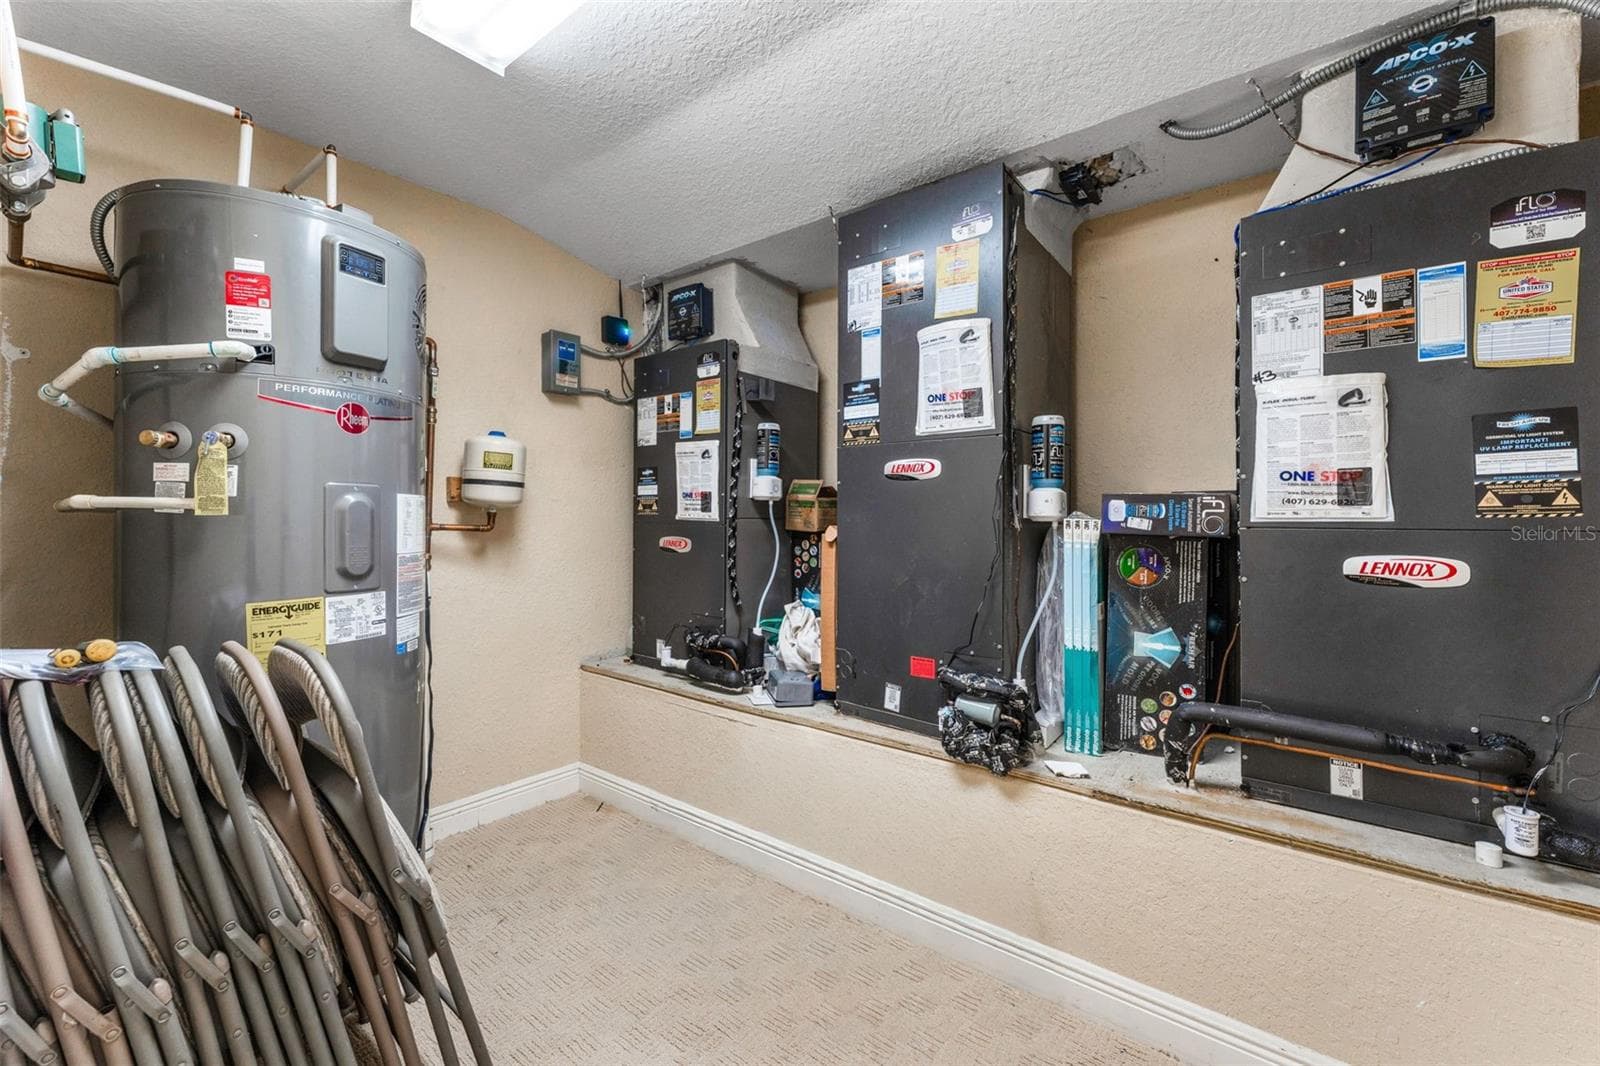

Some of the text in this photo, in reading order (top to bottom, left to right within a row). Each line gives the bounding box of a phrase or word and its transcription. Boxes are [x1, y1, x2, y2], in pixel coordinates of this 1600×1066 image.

[1372, 32, 1477, 75] APCO-X
[1503, 286, 1526, 294] UNITED
[1493, 305, 1557, 317] 407-774-9850
[1253, 370, 1277, 384] #3
[274, 382, 366, 400] PERFORMANCE
[927, 393, 947, 404] ONE
[340, 402, 370, 429] Rheem
[1500, 437, 1549, 445] IMPORTANT!
[1514, 441, 1572, 450] REPLACEMENT
[891, 463, 926, 474] LENNOX
[1280, 470, 1315, 482] ONE
[1281, 498, 1307, 506] (407)
[1201, 496, 1226, 535] iFLO
[1359, 561, 1437, 577] LENNOX
[252, 602, 320, 619] ENERGYGUIDE
